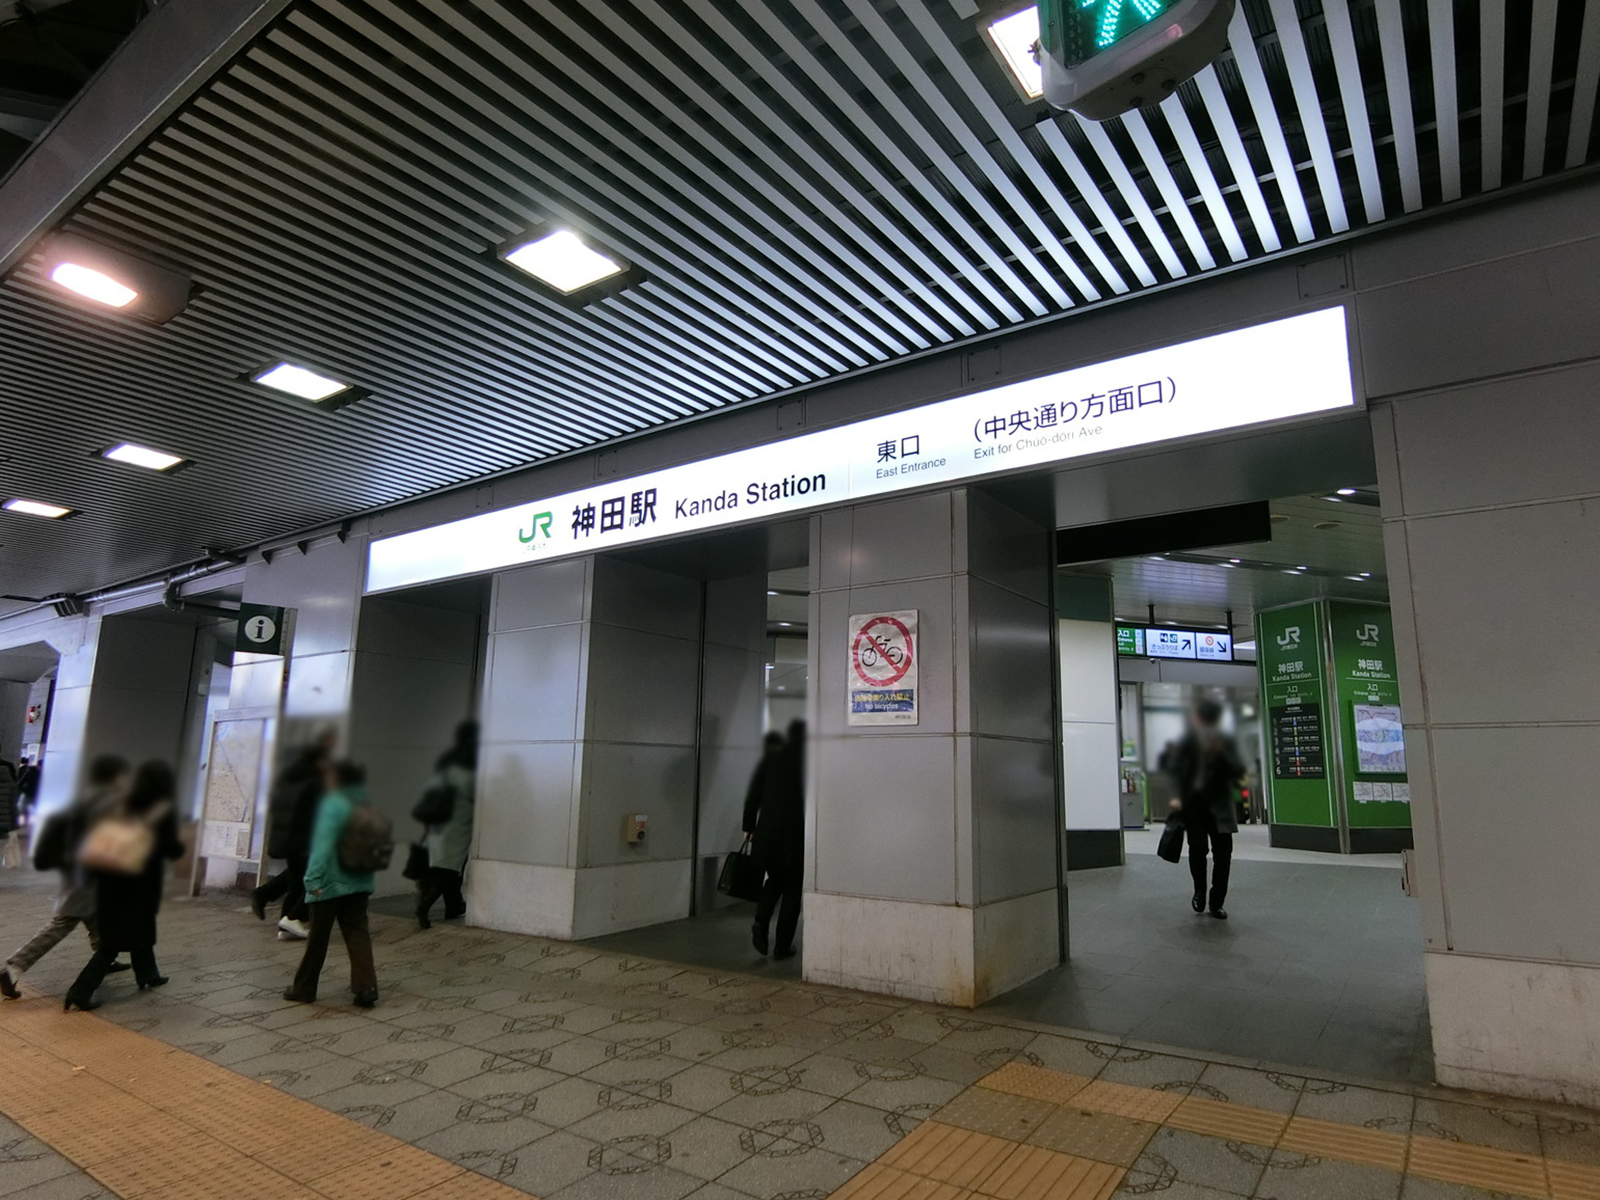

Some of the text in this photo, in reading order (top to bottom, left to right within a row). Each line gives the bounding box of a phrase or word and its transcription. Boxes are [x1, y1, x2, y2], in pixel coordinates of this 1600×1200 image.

[974, 377, 1176, 442] (中央通り方面口)
[877, 435, 920, 463] 東口
[974, 446, 995, 459] Exit
[998, 442, 1012, 453] for
[876, 456, 946, 479] East Entrance
[675, 473, 826, 519] Kanda Station
[571, 488, 658, 539] 神田駅
[519, 511, 553, 543] JR
[1117, 629, 1130, 637] 入口
[1276, 626, 1301, 645] JR
[1356, 624, 1379, 642] JR
[1278, 661, 1304, 673] 神田駅
[1357, 658, 1383, 671] 神田駅
[1272, 672, 1312, 682] Kanda Station
[1352, 670, 1391, 679] Kanda Station
[874, 702, 899, 711] bicycles
